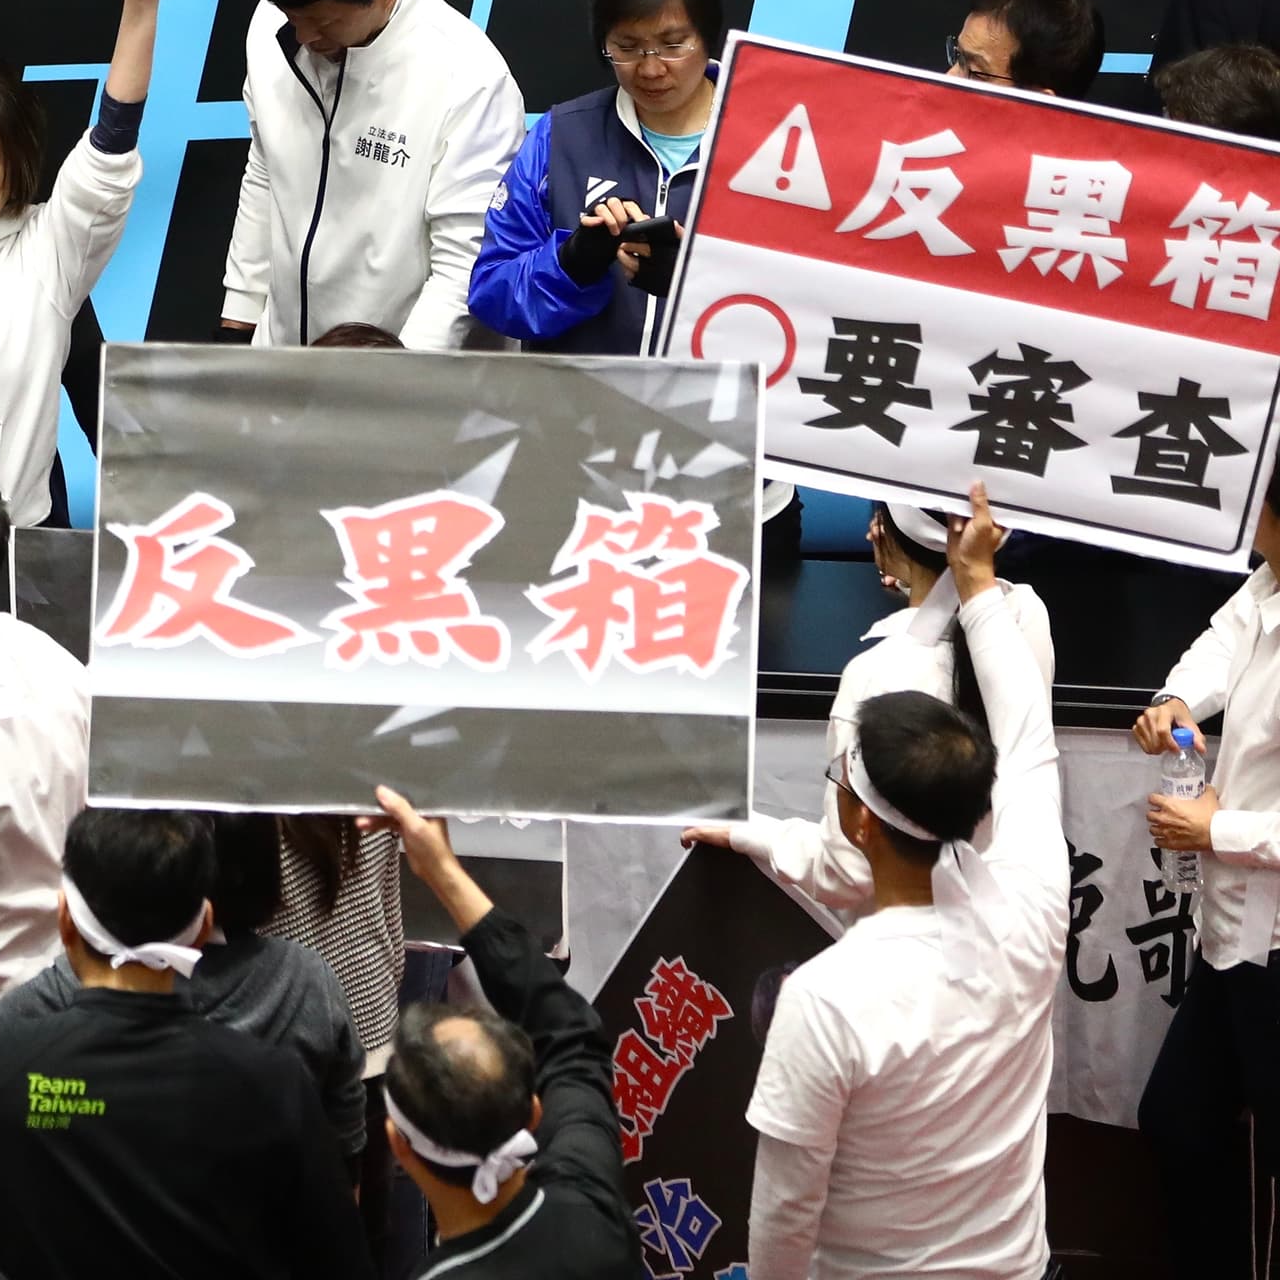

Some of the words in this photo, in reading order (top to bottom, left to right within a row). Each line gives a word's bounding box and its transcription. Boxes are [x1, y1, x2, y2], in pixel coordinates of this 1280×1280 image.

[355, 135, 411, 169] 謝龍介
[368, 126, 407, 145] 立法委員
[836, 129, 1280, 321] 反黑箱
[797, 316, 1254, 511] 要審查
[99, 489, 751, 684] 反黑箱
[27, 1072, 86, 1096] Team
[29, 1093, 106, 1116] Taiwan
